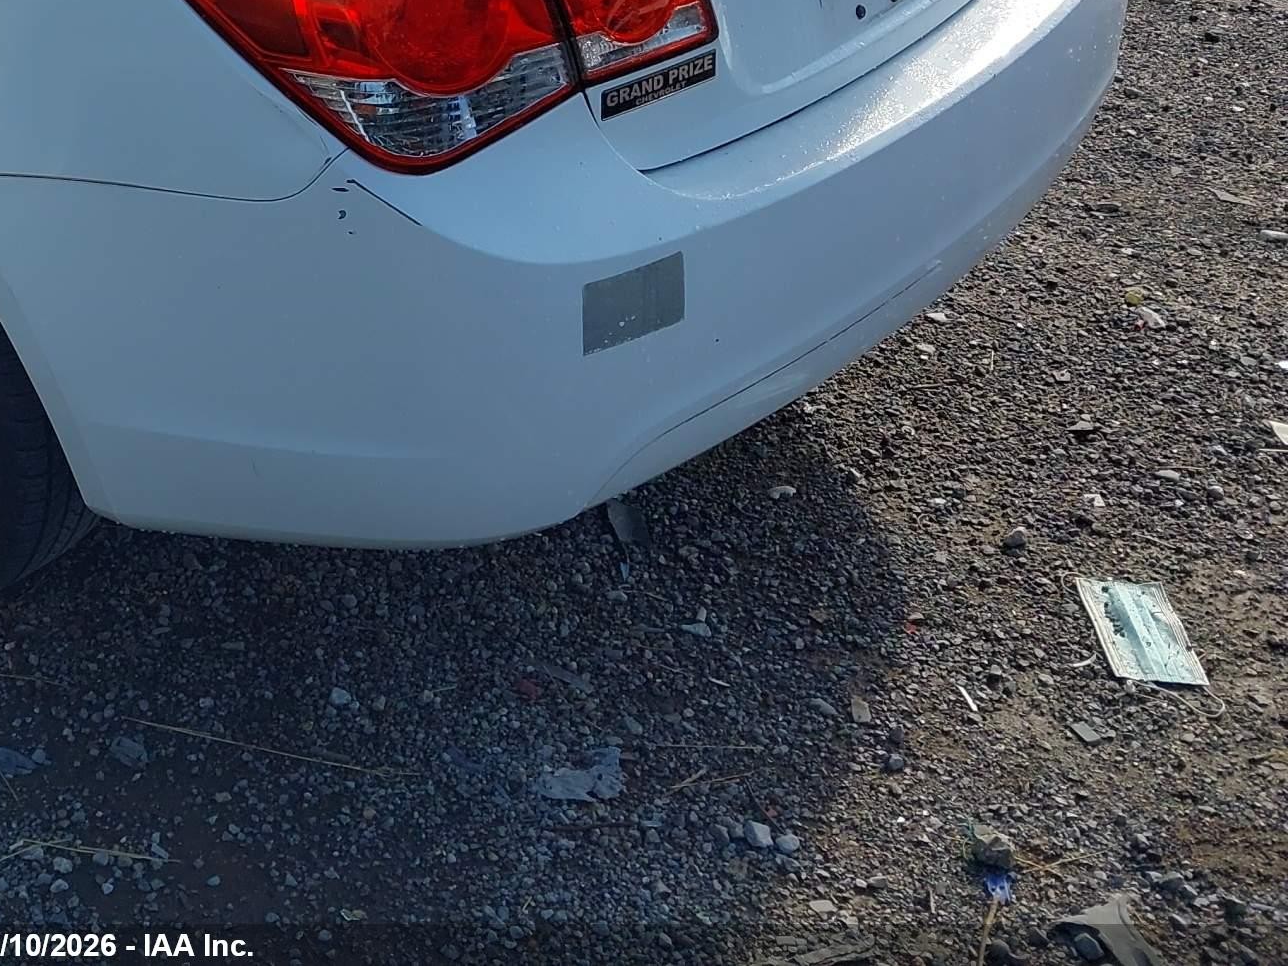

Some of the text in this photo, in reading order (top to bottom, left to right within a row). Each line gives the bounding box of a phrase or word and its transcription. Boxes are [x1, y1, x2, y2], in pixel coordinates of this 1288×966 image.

[606, 55, 713, 107] GRAND PRIZE
[635, 80, 688, 106] CHEVROLET
